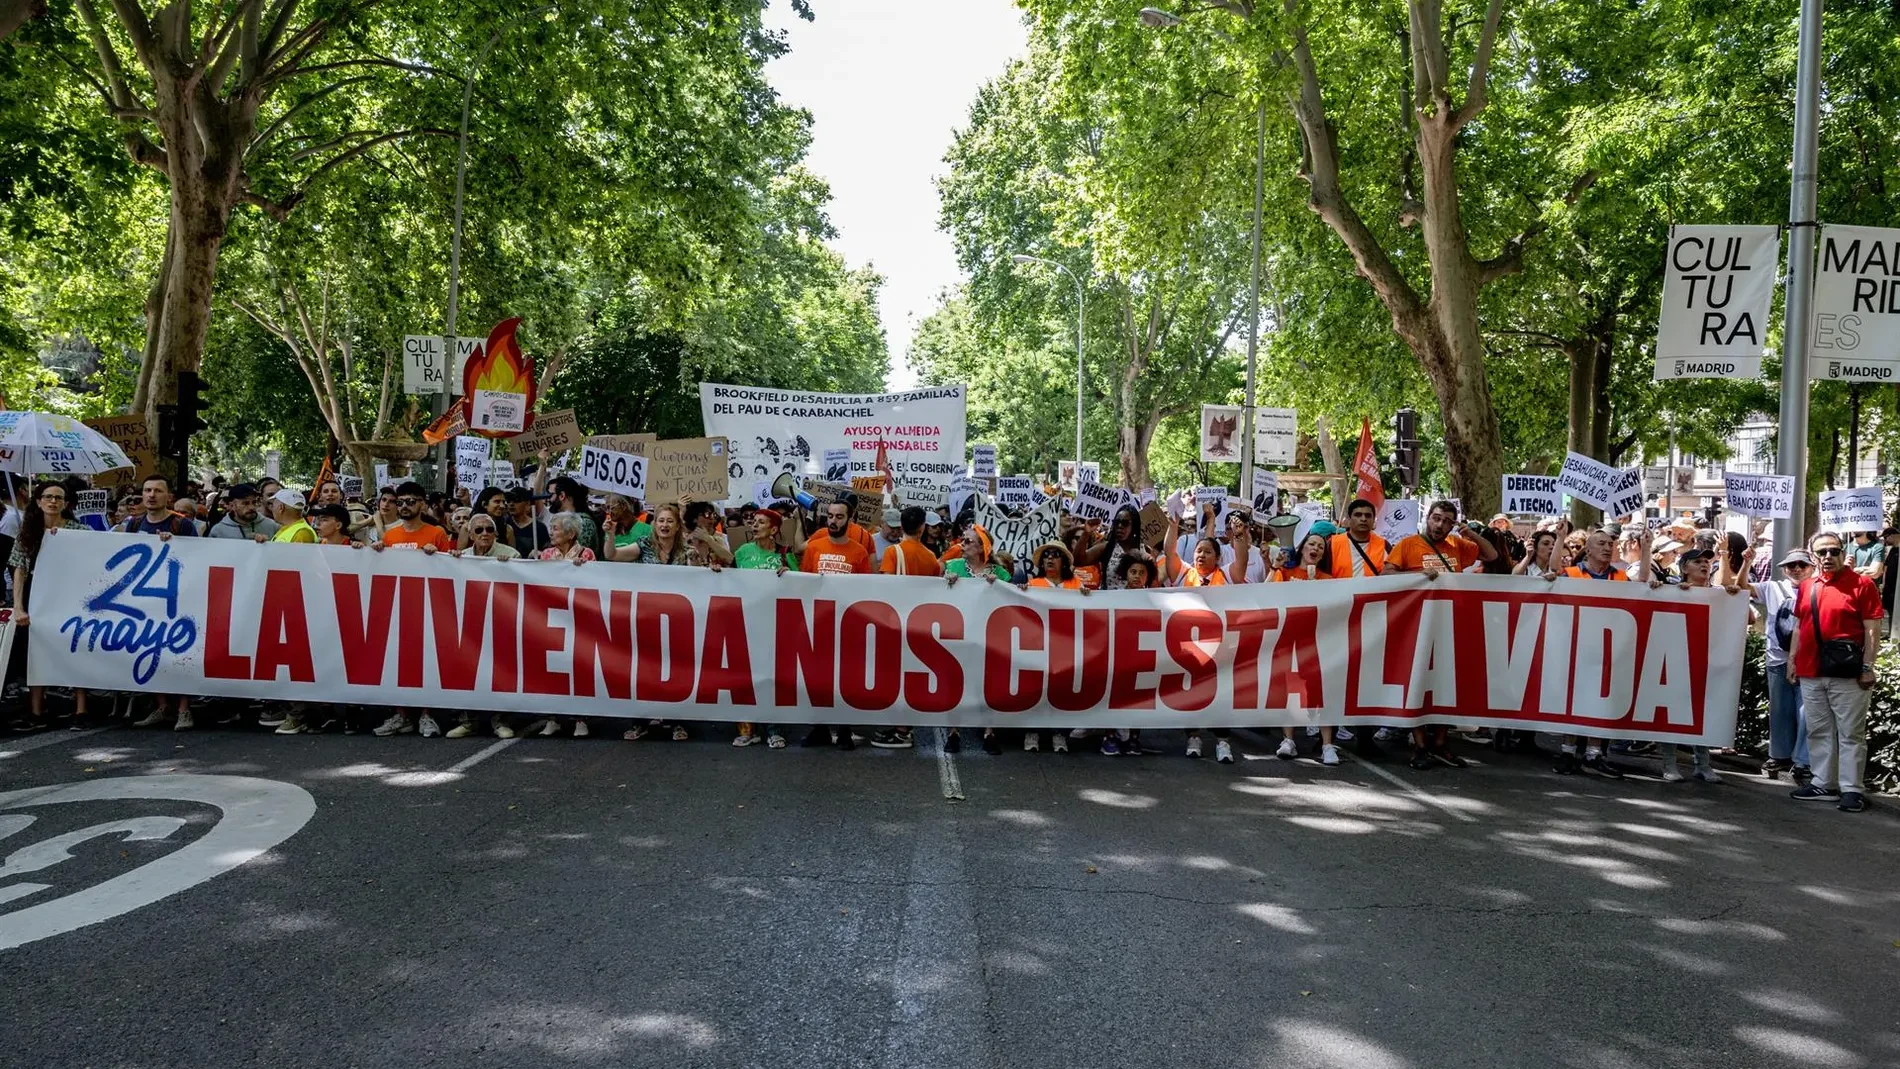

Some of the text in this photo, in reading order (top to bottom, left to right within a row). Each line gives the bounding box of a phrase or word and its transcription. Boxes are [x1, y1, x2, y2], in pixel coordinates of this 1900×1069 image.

[1673, 237, 1751, 272] CUL
[1681, 275, 1734, 308] TU
[1700, 312, 1757, 346] RA
[1814, 313, 1862, 350] ES
[406, 339, 438, 353] CUL
[458, 341, 484, 355] MA
[412, 354, 433, 368] TU
[1686, 363, 1735, 375] MADRID
[424, 368, 444, 382] RA
[1843, 366, 1892, 380] MADRID
[714, 387, 788, 402] BROOKFIELD
[792, 394, 862, 404] DESAHUCIA
[877, 394, 900, 403] 859
[904, 387, 959, 402] FAMILIAS
[714, 404, 874, 418] DEL PAU DE CARABANCHEL
[535, 414, 574, 431] RENTISTAS
[536, 428, 547, 437] DEL
[844, 426, 940, 436] AYUSO Y ALMEIDA
[518, 432, 569, 454] HENARES
[852, 440, 938, 451] RESPONSABLES
[654, 446, 708, 464] Queremos
[662, 466, 708, 477] VECINAS
[1564, 458, 1608, 485] DESAHUCIAR,
[656, 478, 724, 496] NO TURISTAS
[1000, 479, 1030, 488] DERECHO
[1558, 474, 1564, 485] A
[1564, 478, 1588, 494] BANCOS
[1588, 487, 1594, 496] &
[1725, 478, 1778, 495] DESAHUCIAR,
[78, 492, 106, 500] RECHO
[1000, 492, 1006, 502] A
[1006, 492, 1030, 502] TECHO.
[1082, 482, 1119, 505] DERECHO
[1076, 502, 1084, 515] A
[1509, 498, 1557, 514] A TECHO.
[1613, 492, 1642, 516] A TECH
[1728, 494, 1732, 505] A
[1732, 496, 1764, 510] BANCOS
[1766, 498, 1772, 510] &
[88, 541, 181, 621] 24
[60, 612, 197, 687] mayo
[204, 566, 1695, 726] LA VIVIENDA NOS CUESTA LA VIDA
